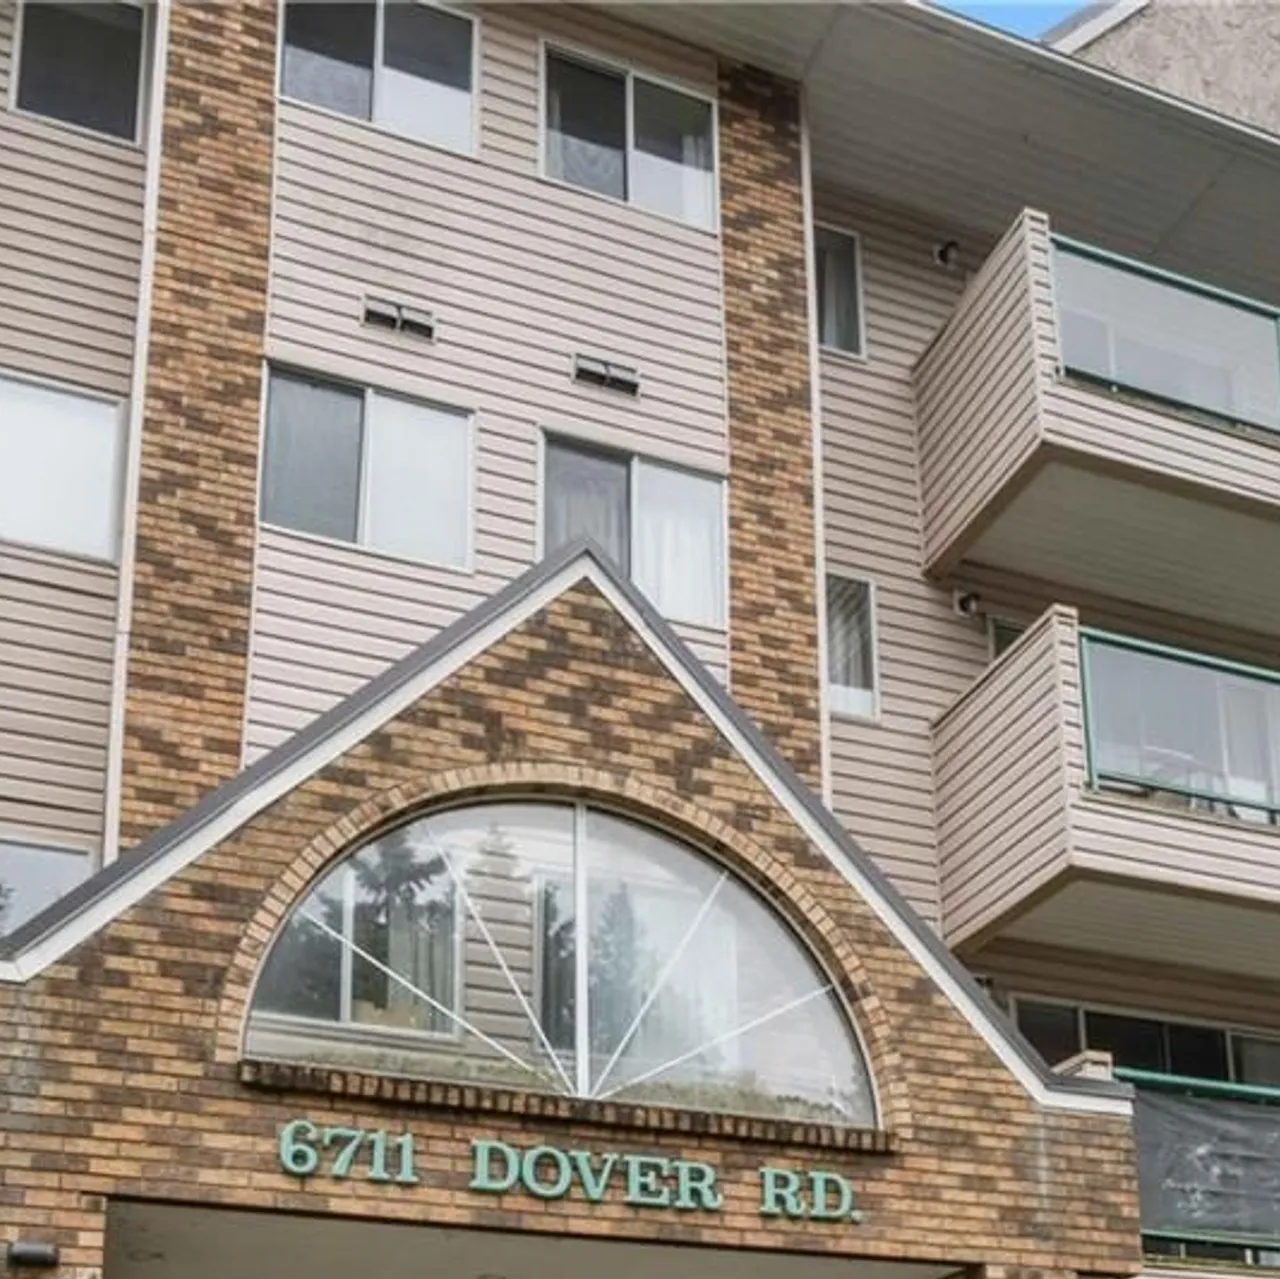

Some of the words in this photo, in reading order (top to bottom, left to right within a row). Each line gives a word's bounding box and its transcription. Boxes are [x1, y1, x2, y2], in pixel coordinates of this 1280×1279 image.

[278, 1119, 418, 1184] 6711
[469, 1138, 723, 1210] DOVER
[759, 1165, 866, 1224] RD.
